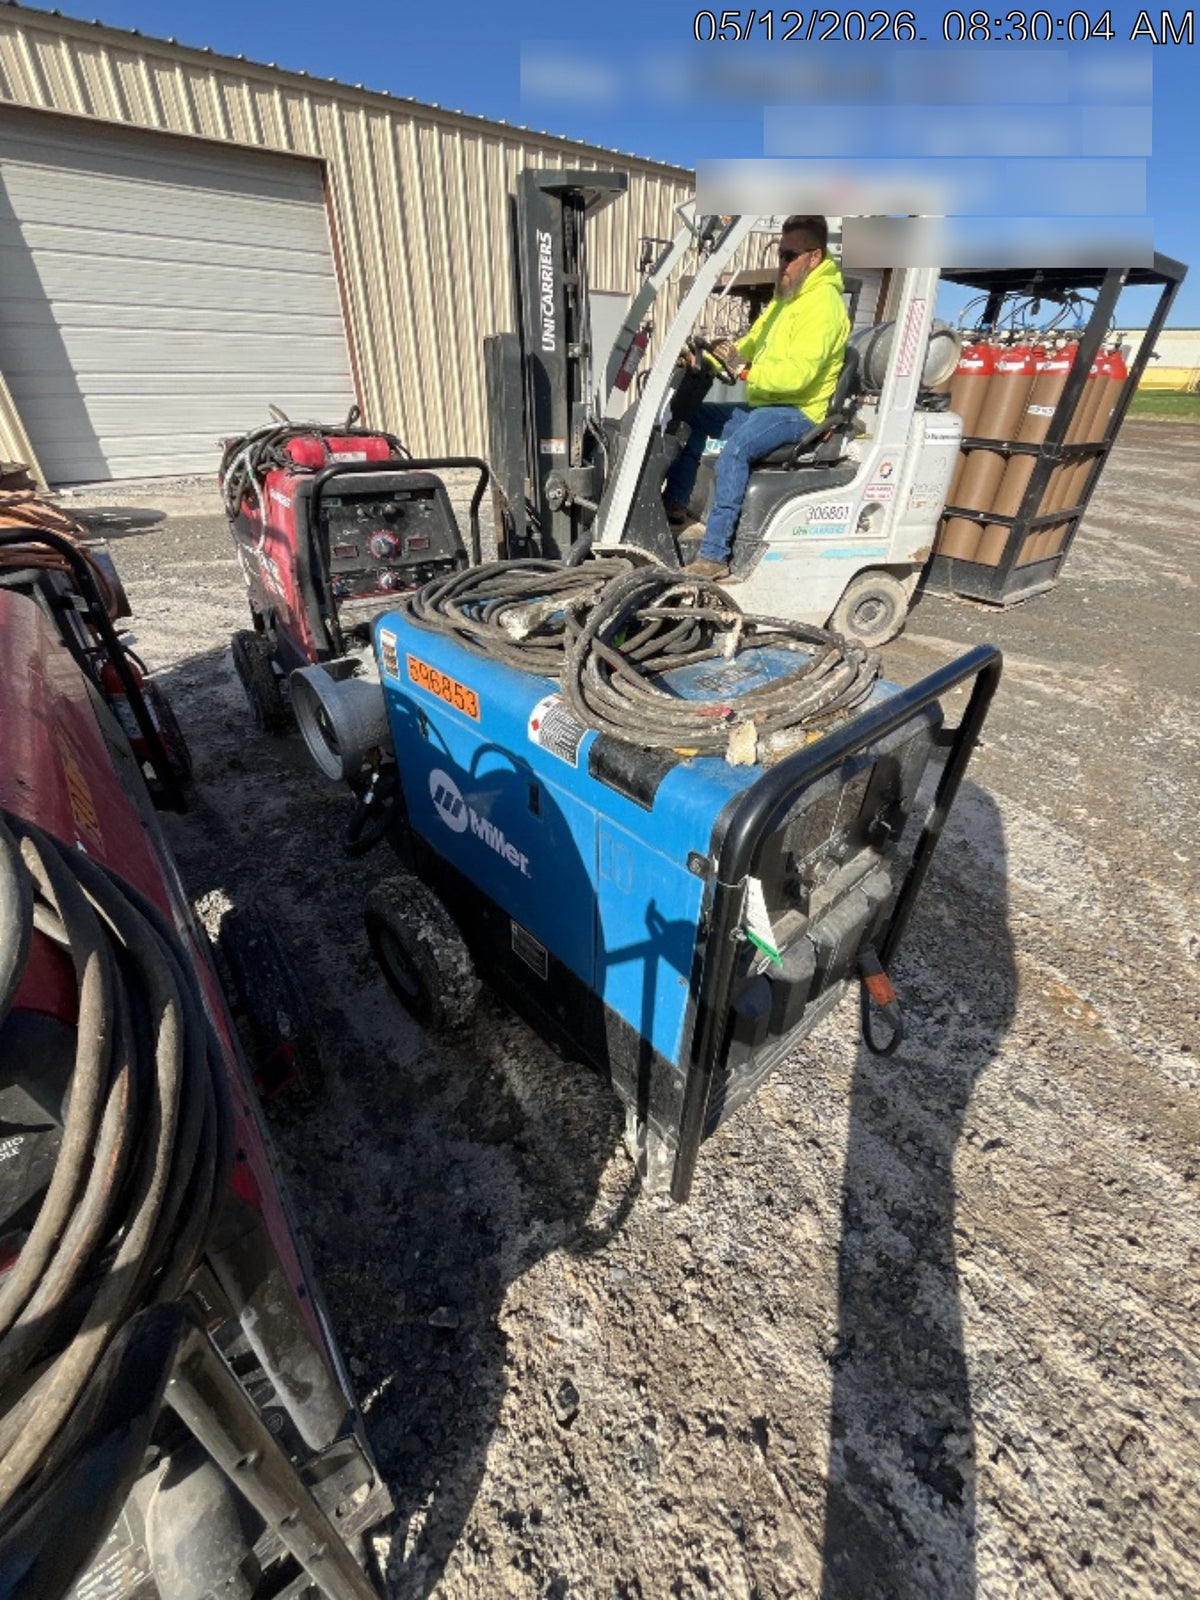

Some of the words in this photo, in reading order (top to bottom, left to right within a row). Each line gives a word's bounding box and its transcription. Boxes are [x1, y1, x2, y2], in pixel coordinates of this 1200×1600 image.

[539, 231, 556, 352] UNICARRIERS
[408, 655, 478, 719] 596853
[468, 805, 529, 876] Miller
